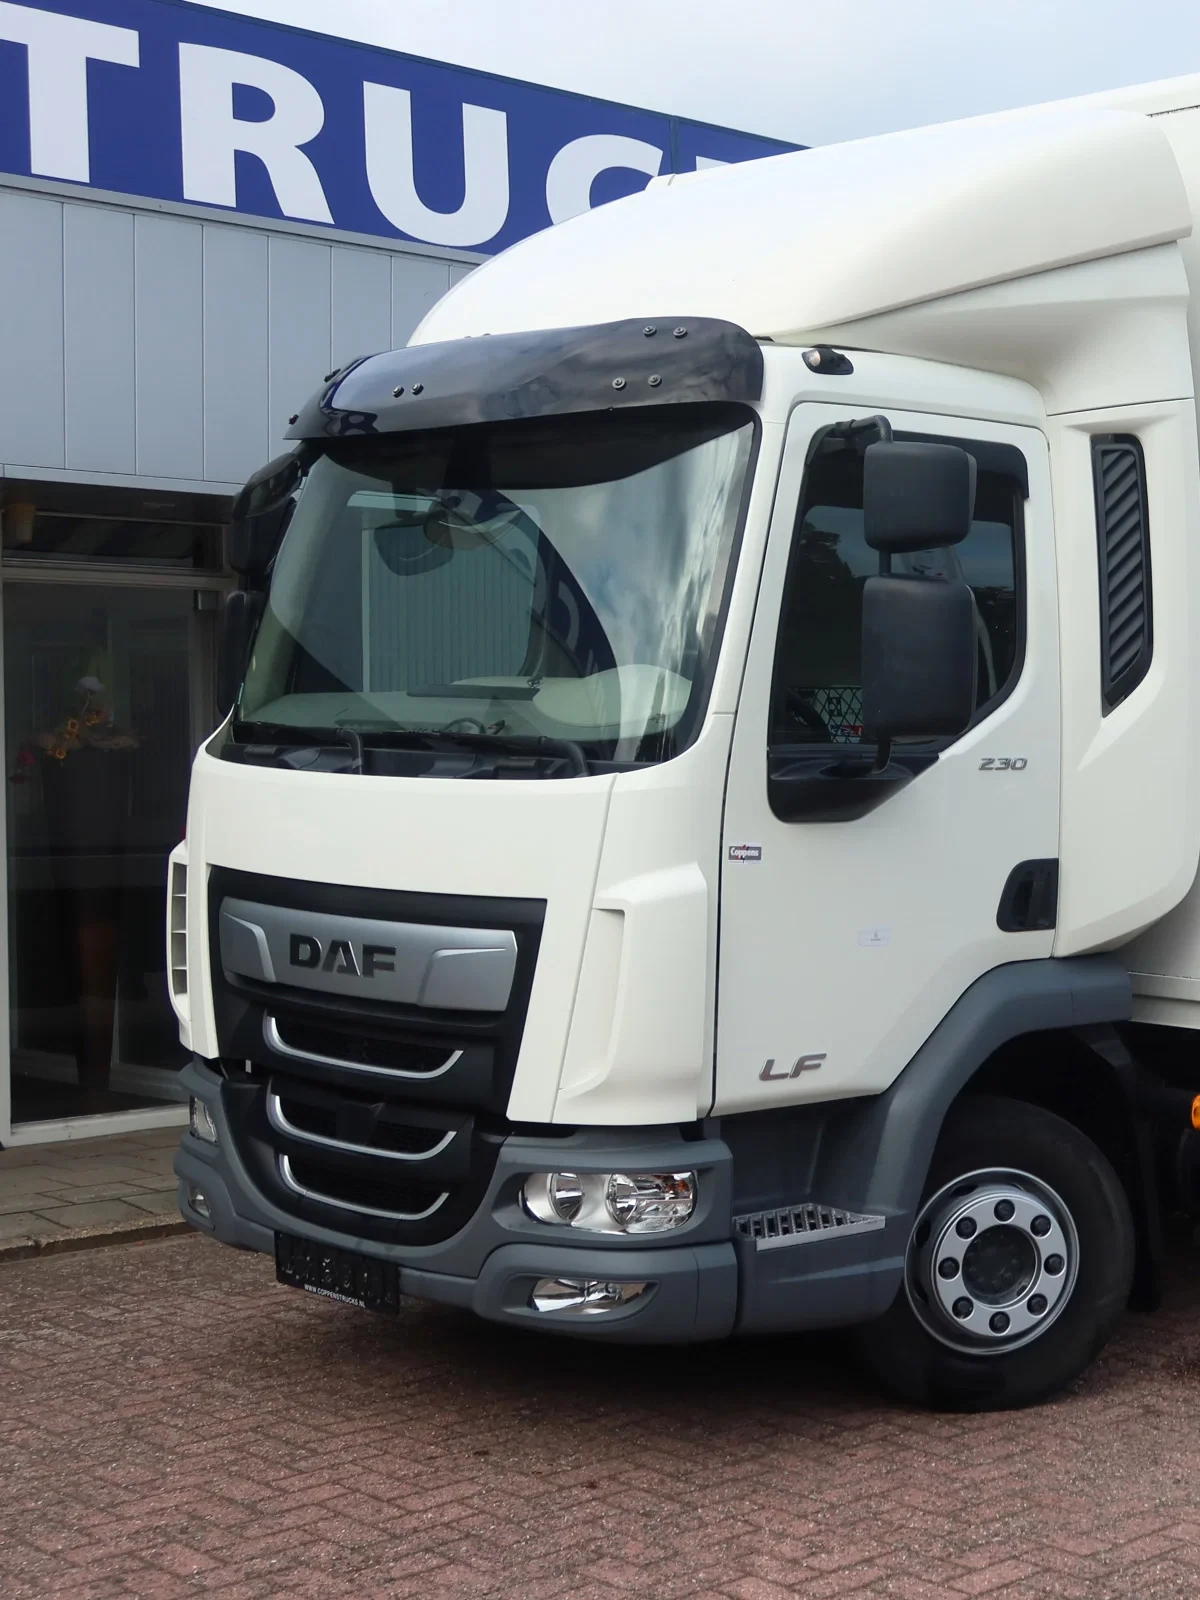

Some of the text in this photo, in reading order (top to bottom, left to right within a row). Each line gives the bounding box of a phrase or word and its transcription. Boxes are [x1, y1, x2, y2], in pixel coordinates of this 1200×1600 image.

[979, 757, 1028, 771] 230
[730, 847, 760, 859] Coppens
[289, 933, 397, 978] DAF
[759, 1053, 827, 1081] LF
